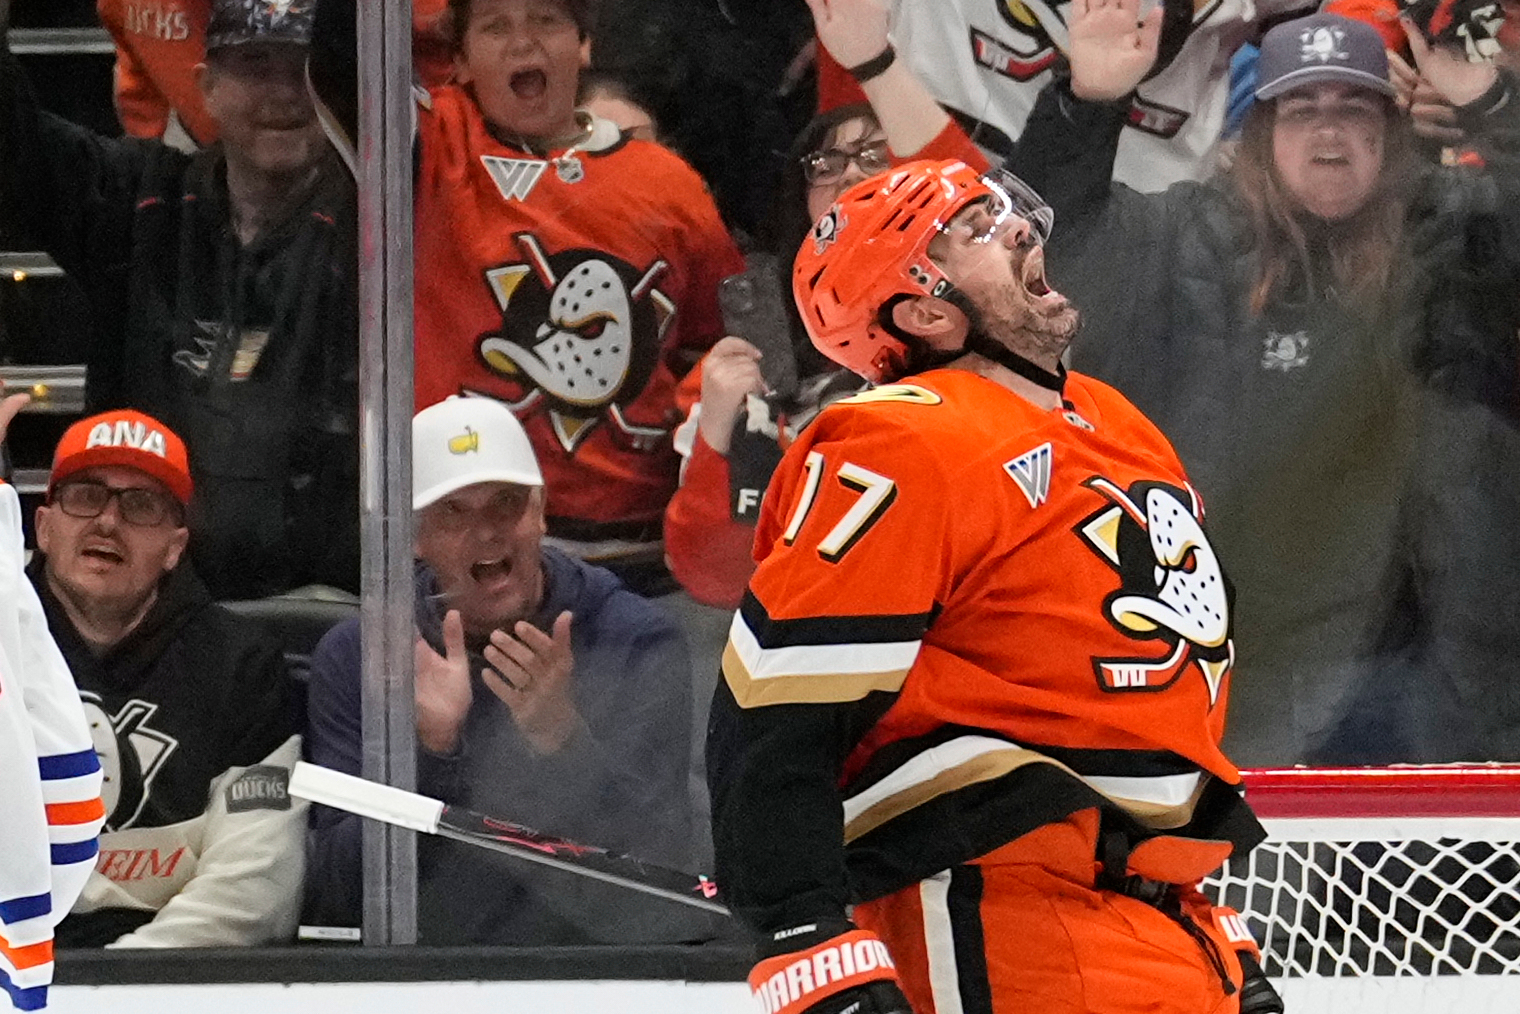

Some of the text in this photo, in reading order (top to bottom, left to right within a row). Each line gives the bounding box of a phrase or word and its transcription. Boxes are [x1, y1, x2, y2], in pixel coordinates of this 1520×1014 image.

[86, 420, 166, 458] ANA
[783, 450, 898, 564] 17
[231, 780, 287, 800] DUCKS
[98, 848, 186, 880] EIM
